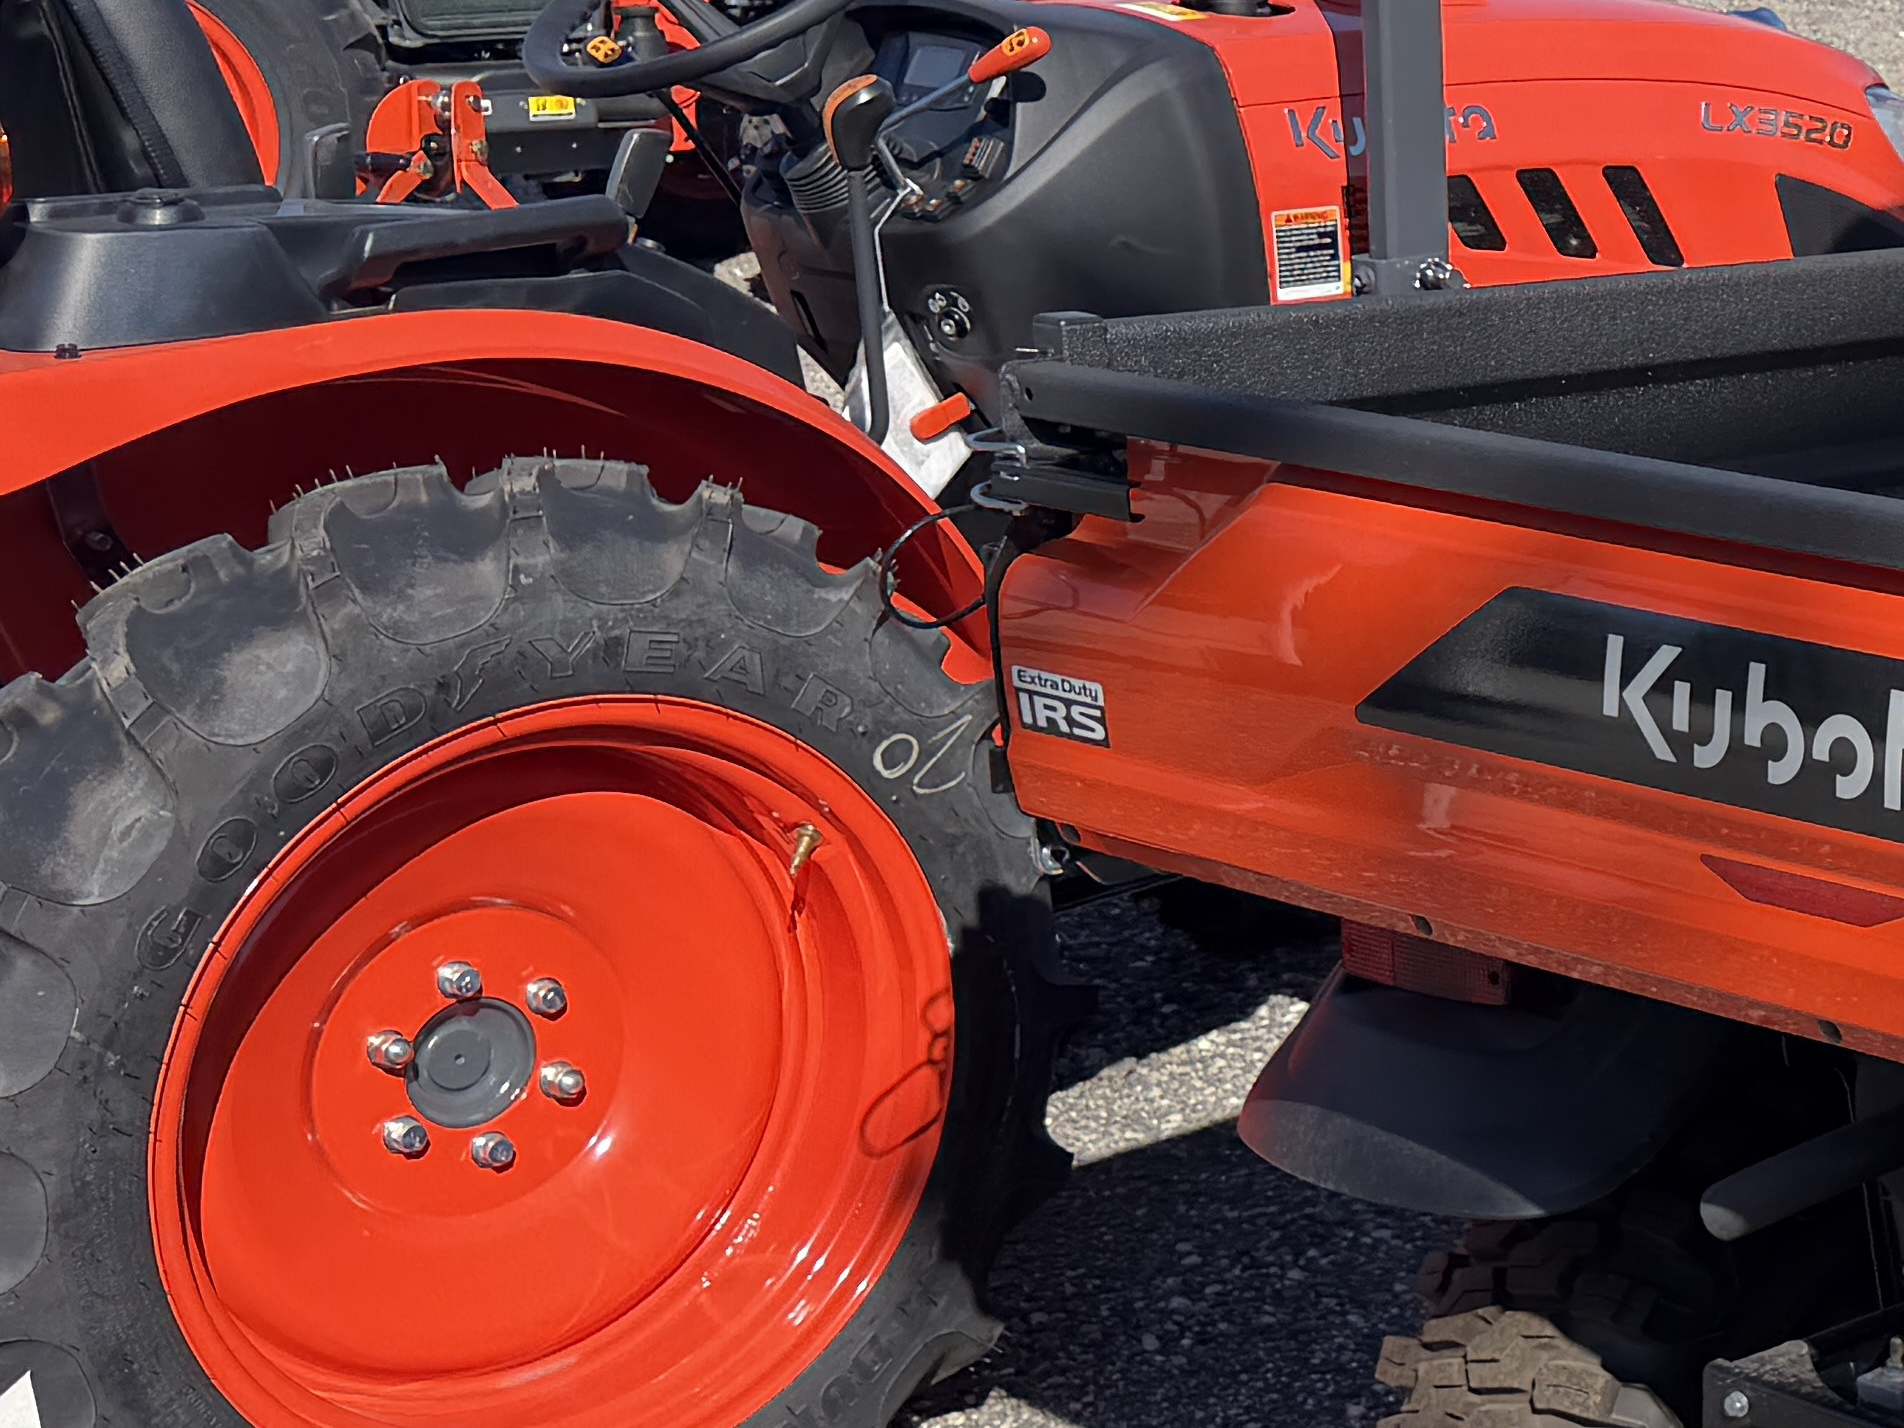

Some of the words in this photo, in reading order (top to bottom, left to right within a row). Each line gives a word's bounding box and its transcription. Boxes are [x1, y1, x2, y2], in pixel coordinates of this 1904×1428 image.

[1284, 104, 1497, 159] Kuta
[1701, 101, 1853, 151] LX3520
[1016, 668, 1060, 691] Extra
[1060, 678, 1099, 703] Duty
[1018, 691, 1106, 741] IRS
[134, 628, 856, 970] GOODYEAR
